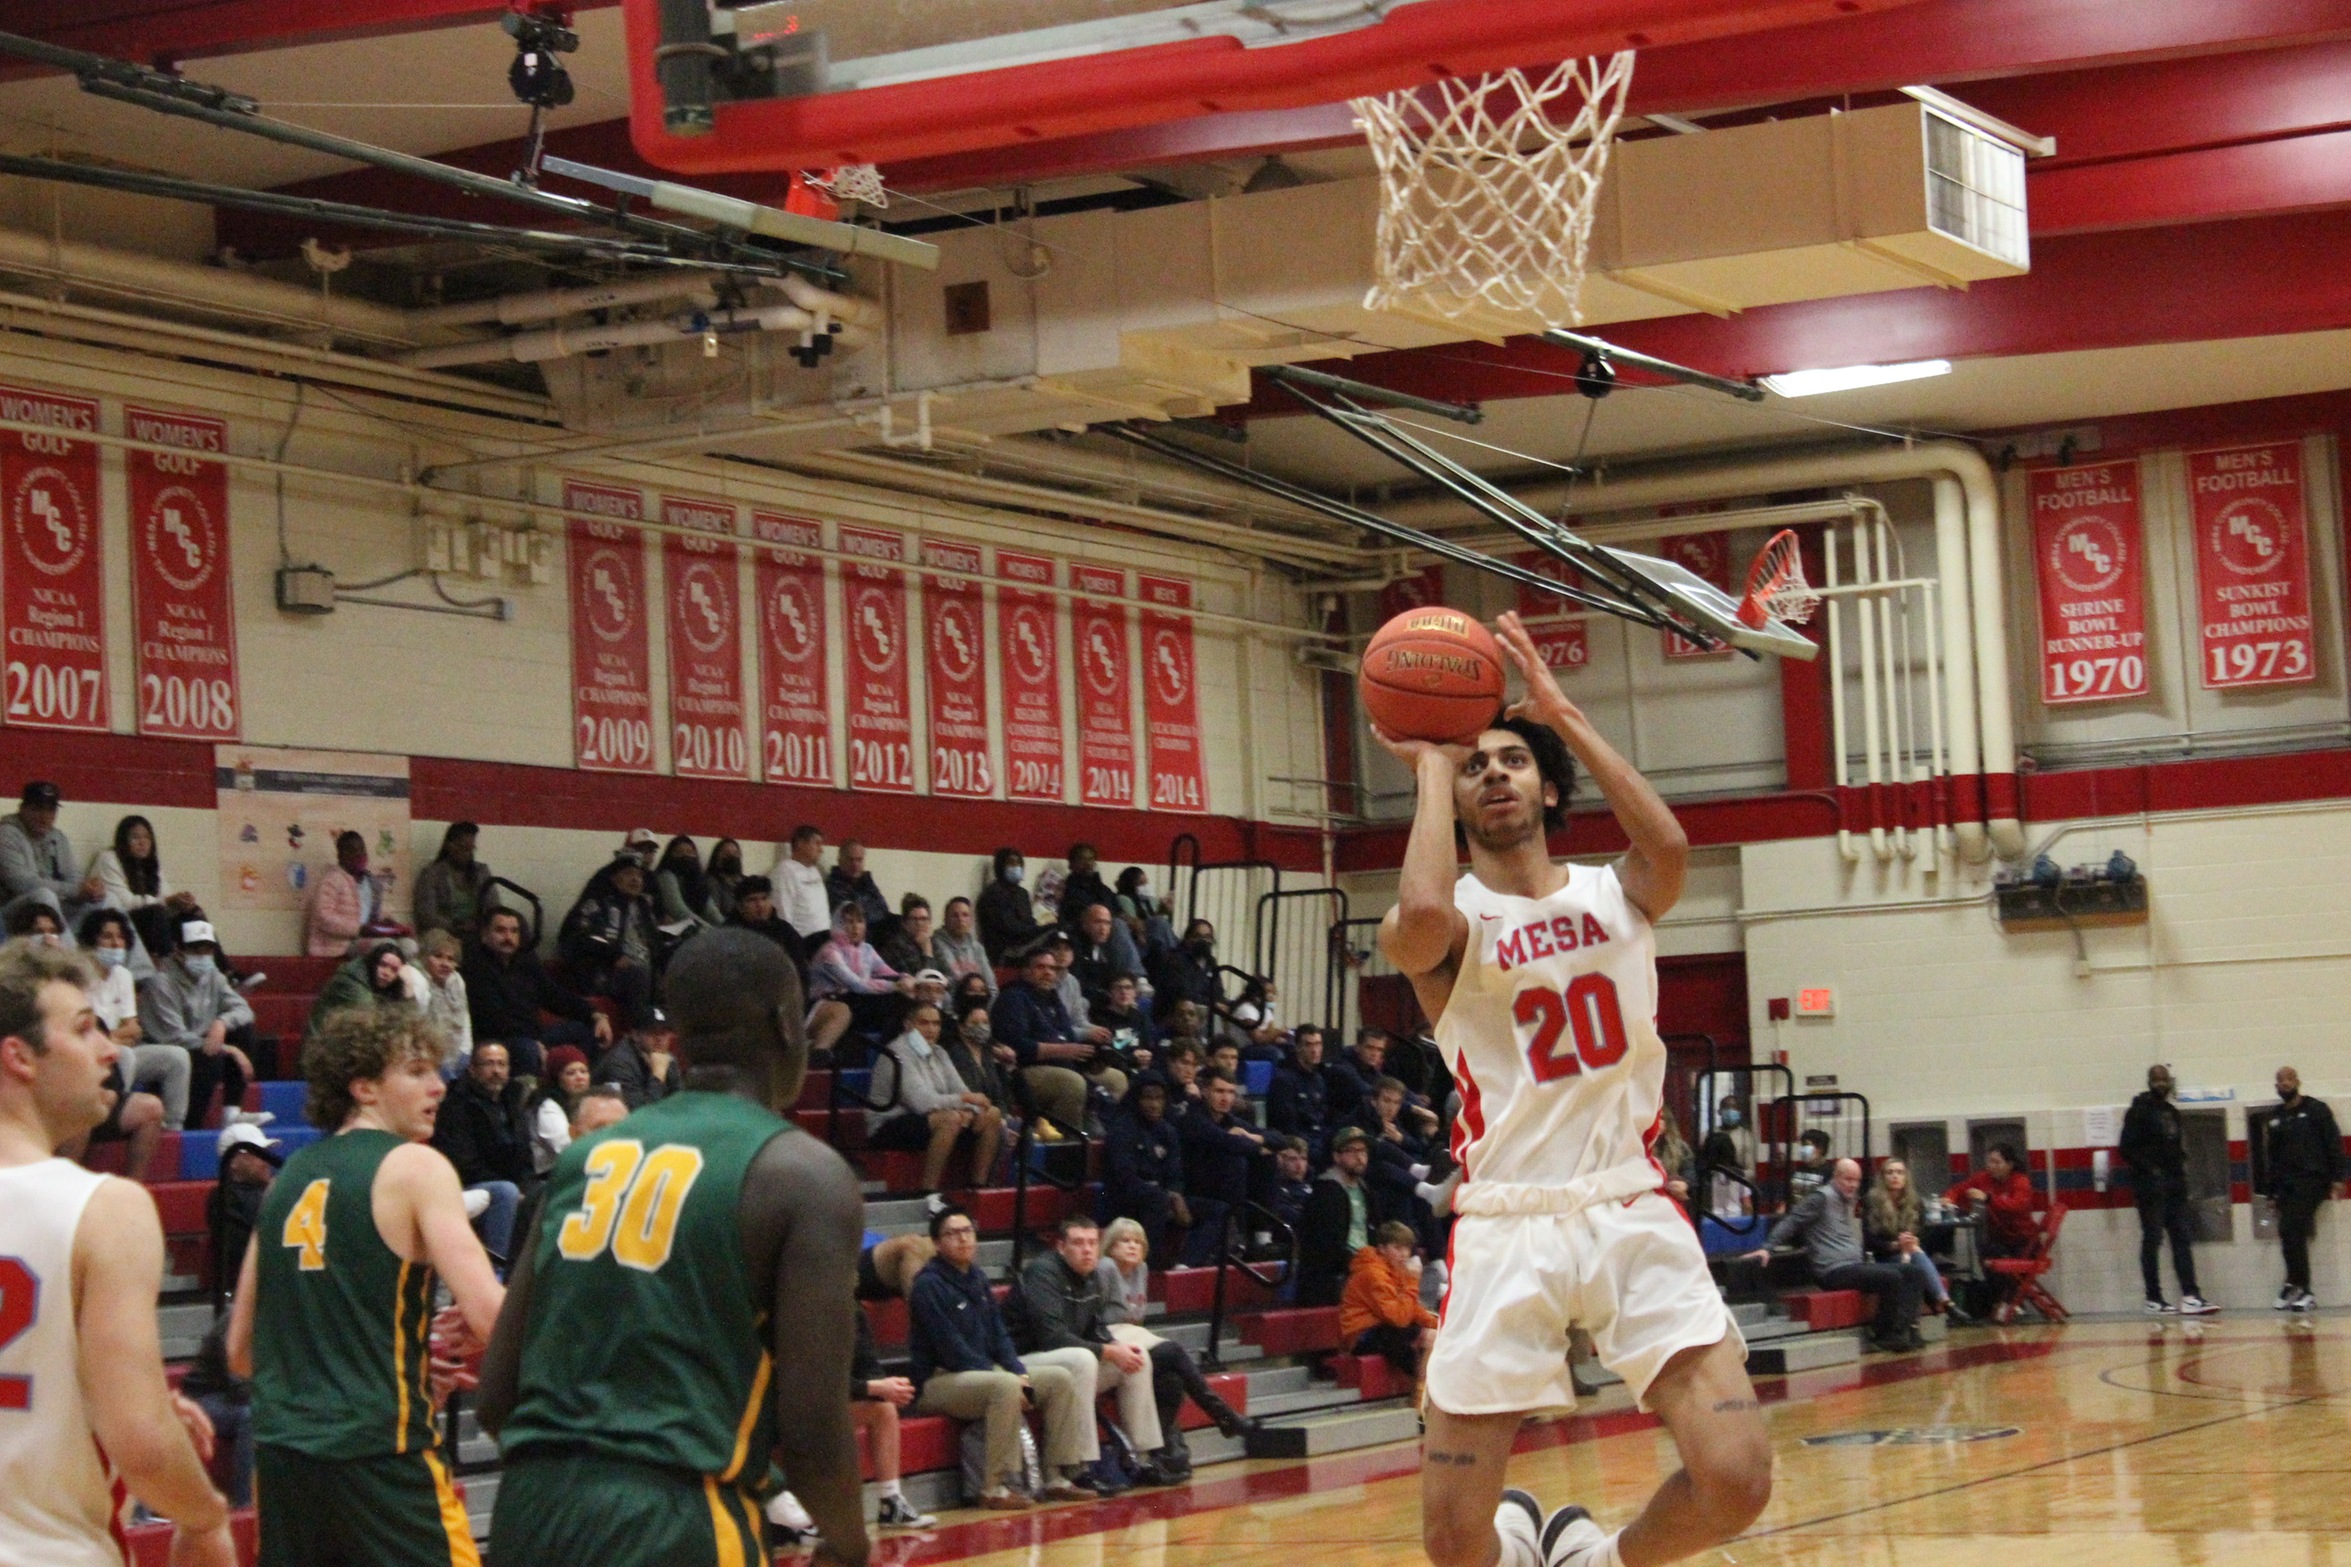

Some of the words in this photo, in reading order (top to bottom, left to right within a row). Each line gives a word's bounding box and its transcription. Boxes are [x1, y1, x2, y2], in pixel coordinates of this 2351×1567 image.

[1, 396, 91, 431] WOMEN'S
[133, 419, 219, 451] WOMEN'S
[2214, 449, 2272, 471] MEN'S
[2056, 468, 2112, 489] MEN'S
[2197, 467, 2295, 494] FOOTBALL
[2037, 486, 2132, 511] FOOTBALL
[2060, 598, 2125, 618] SHRINE
[2216, 581, 2291, 602] SUNKIST
[2067, 617, 2119, 635] BOWL
[2229, 600, 2281, 618] BOWL
[10, 627, 100, 652] CHAMPIONS
[2046, 632, 2144, 654] RUNNER-UP
[2204, 615, 2309, 639] CHAMPIONS
[143, 641, 229, 665] CHAMPIONS
[1386, 650, 1481, 682] SPALDING
[1538, 641, 1584, 664] 976
[2210, 639, 2307, 681] 1973
[7, 661, 101, 720] 2007
[2050, 655, 2143, 696] 1970
[143, 673, 234, 731] 2008
[580, 715, 650, 764] 2009
[675, 723, 744, 772] 2010
[765, 730, 830, 779] 2011
[853, 738, 913, 785] 2012
[935, 746, 990, 792] 2013
[1013, 759, 1060, 795] 2014
[1086, 766, 1131, 801] 2014
[1154, 773, 1199, 806] 2014
[1496, 912, 1609, 972] MESA
[1512, 971, 1629, 1085] 20
[556, 1138, 704, 1273] 30
[282, 1178, 330, 1271] 4
